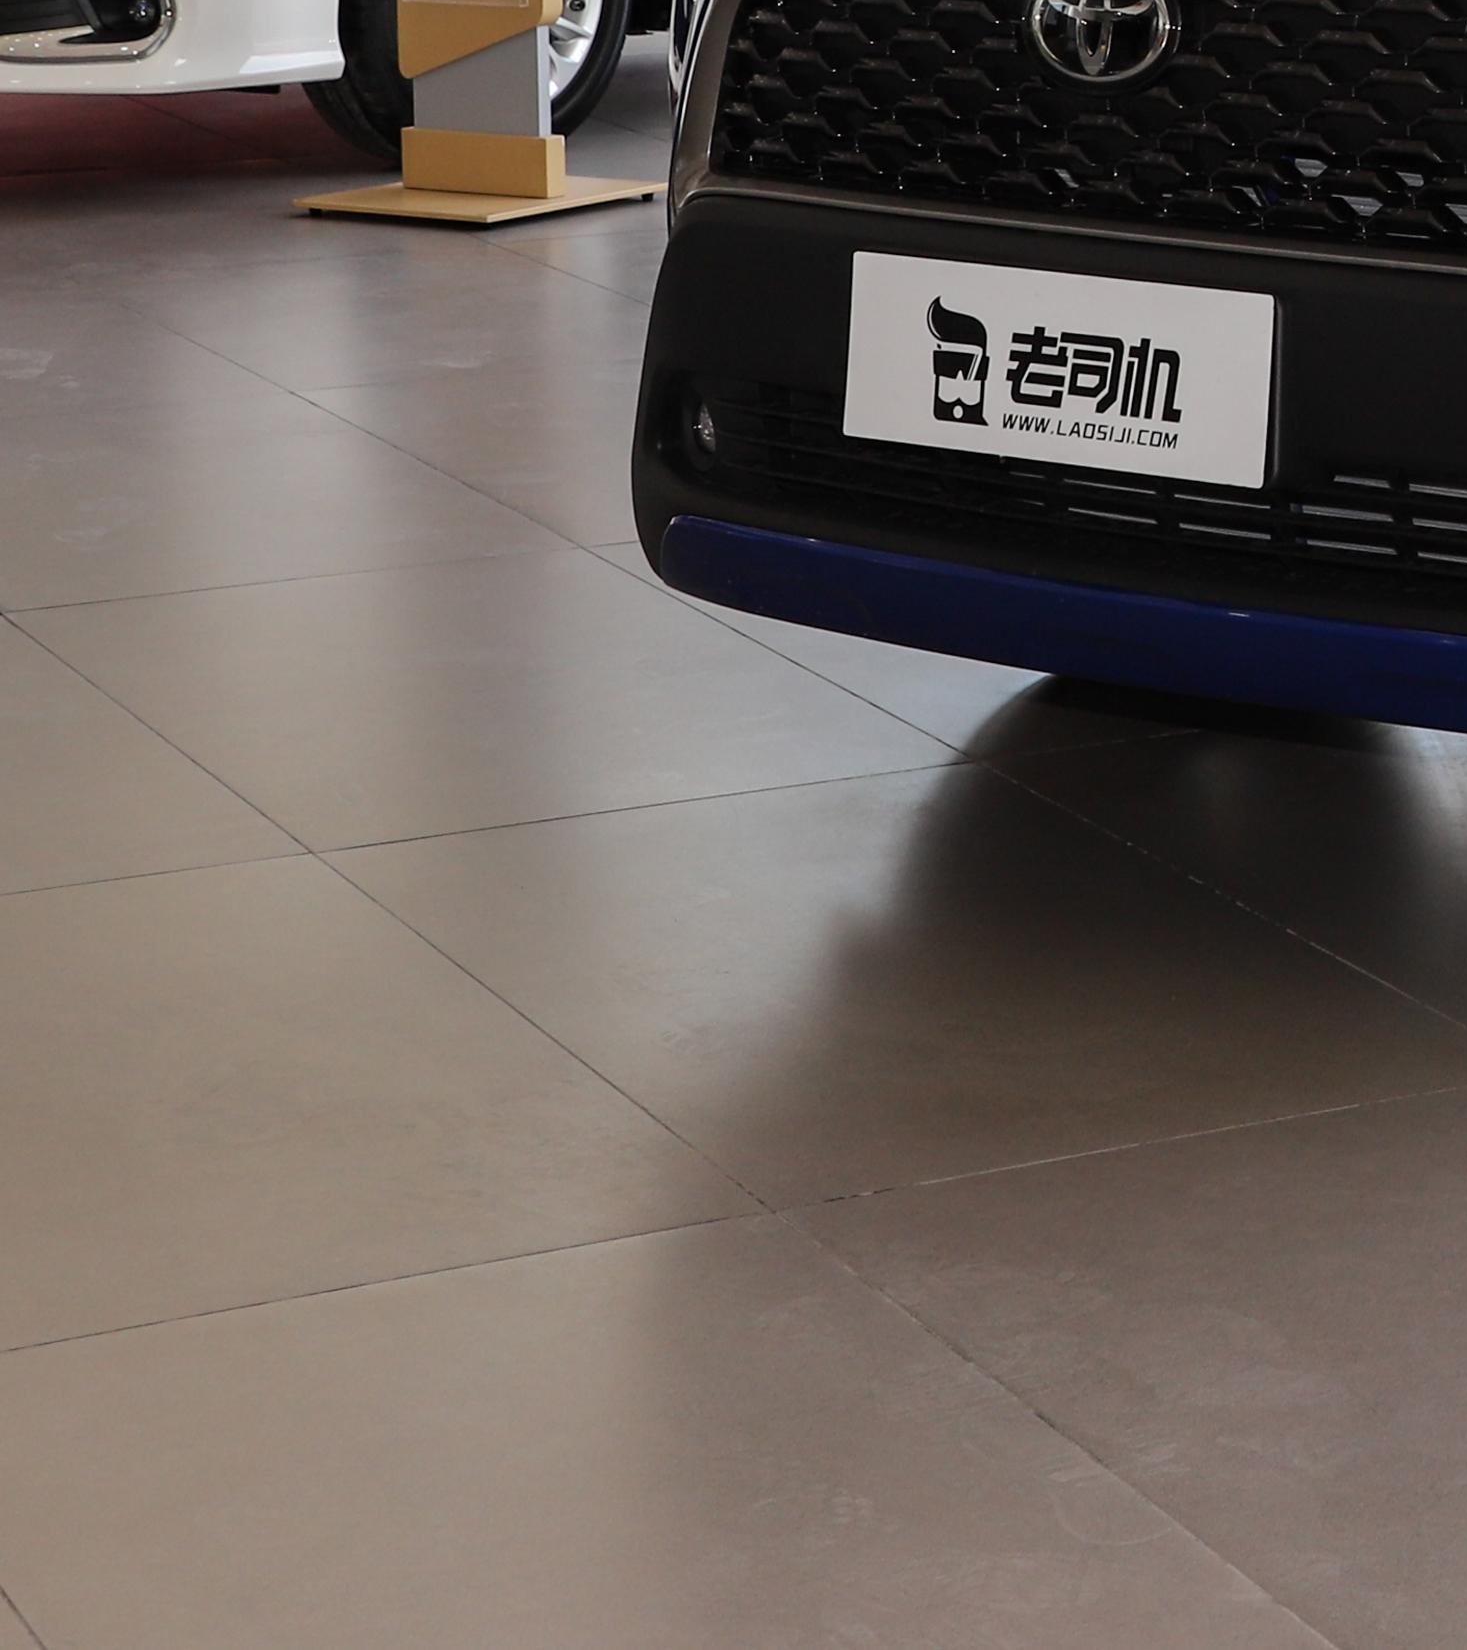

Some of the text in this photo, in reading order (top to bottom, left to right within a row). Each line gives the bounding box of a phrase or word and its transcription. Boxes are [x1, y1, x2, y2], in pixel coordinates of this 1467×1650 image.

[1005, 325, 1183, 424] 老司机
[1002, 412, 1179, 450] WWW.LAOSIJI.COM
